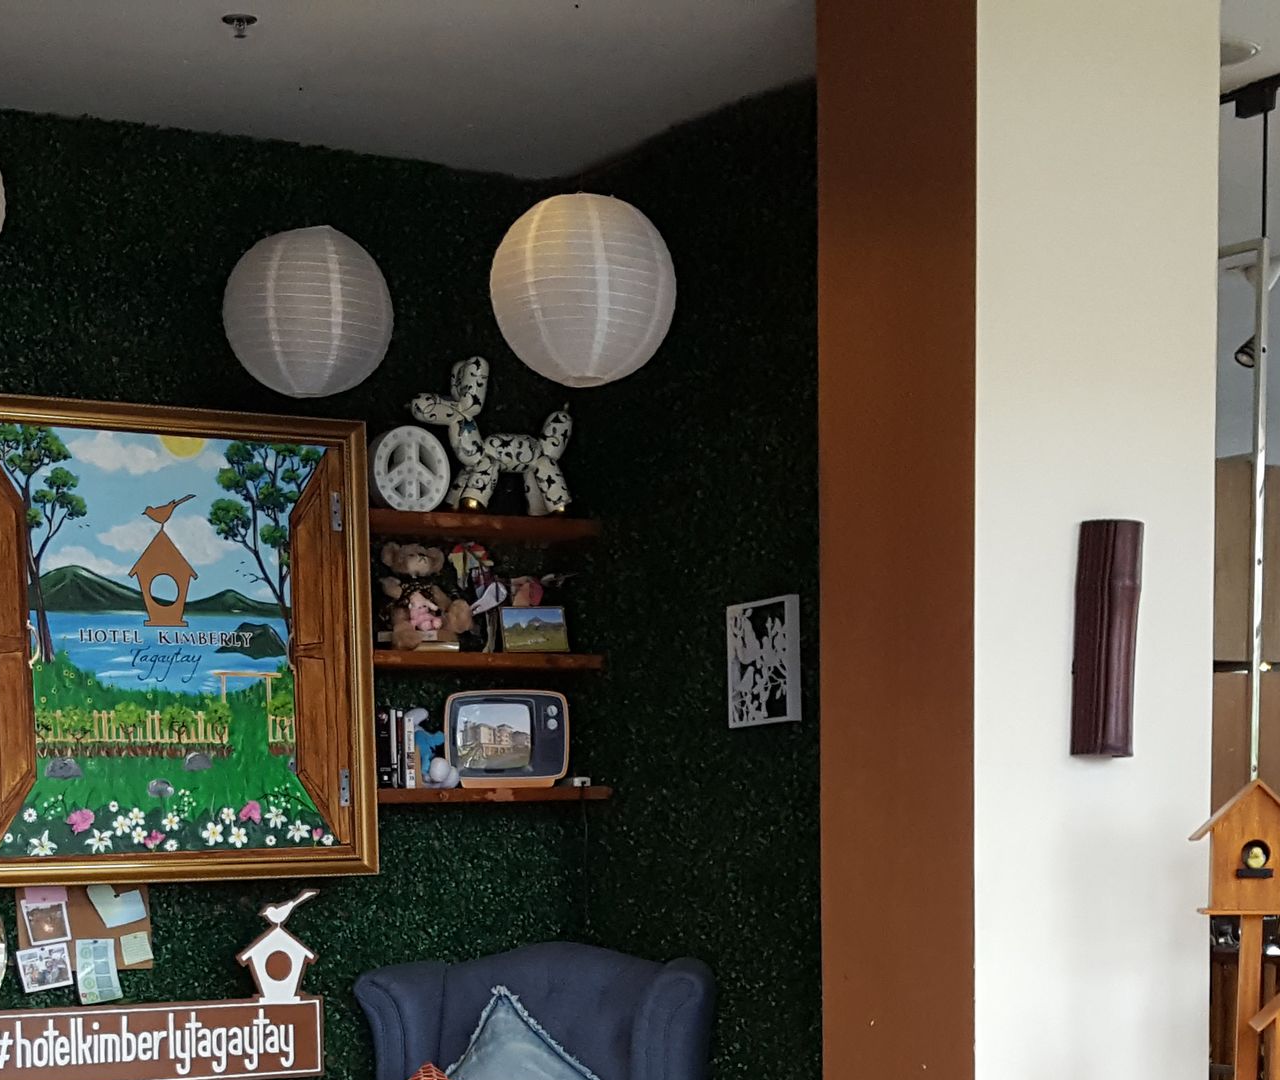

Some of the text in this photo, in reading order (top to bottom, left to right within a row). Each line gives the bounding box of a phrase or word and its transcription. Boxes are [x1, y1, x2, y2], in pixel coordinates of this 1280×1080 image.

[79, 628, 253, 647] HOTEL KIMBERLY
[130, 645, 202, 683] Tagaytay
